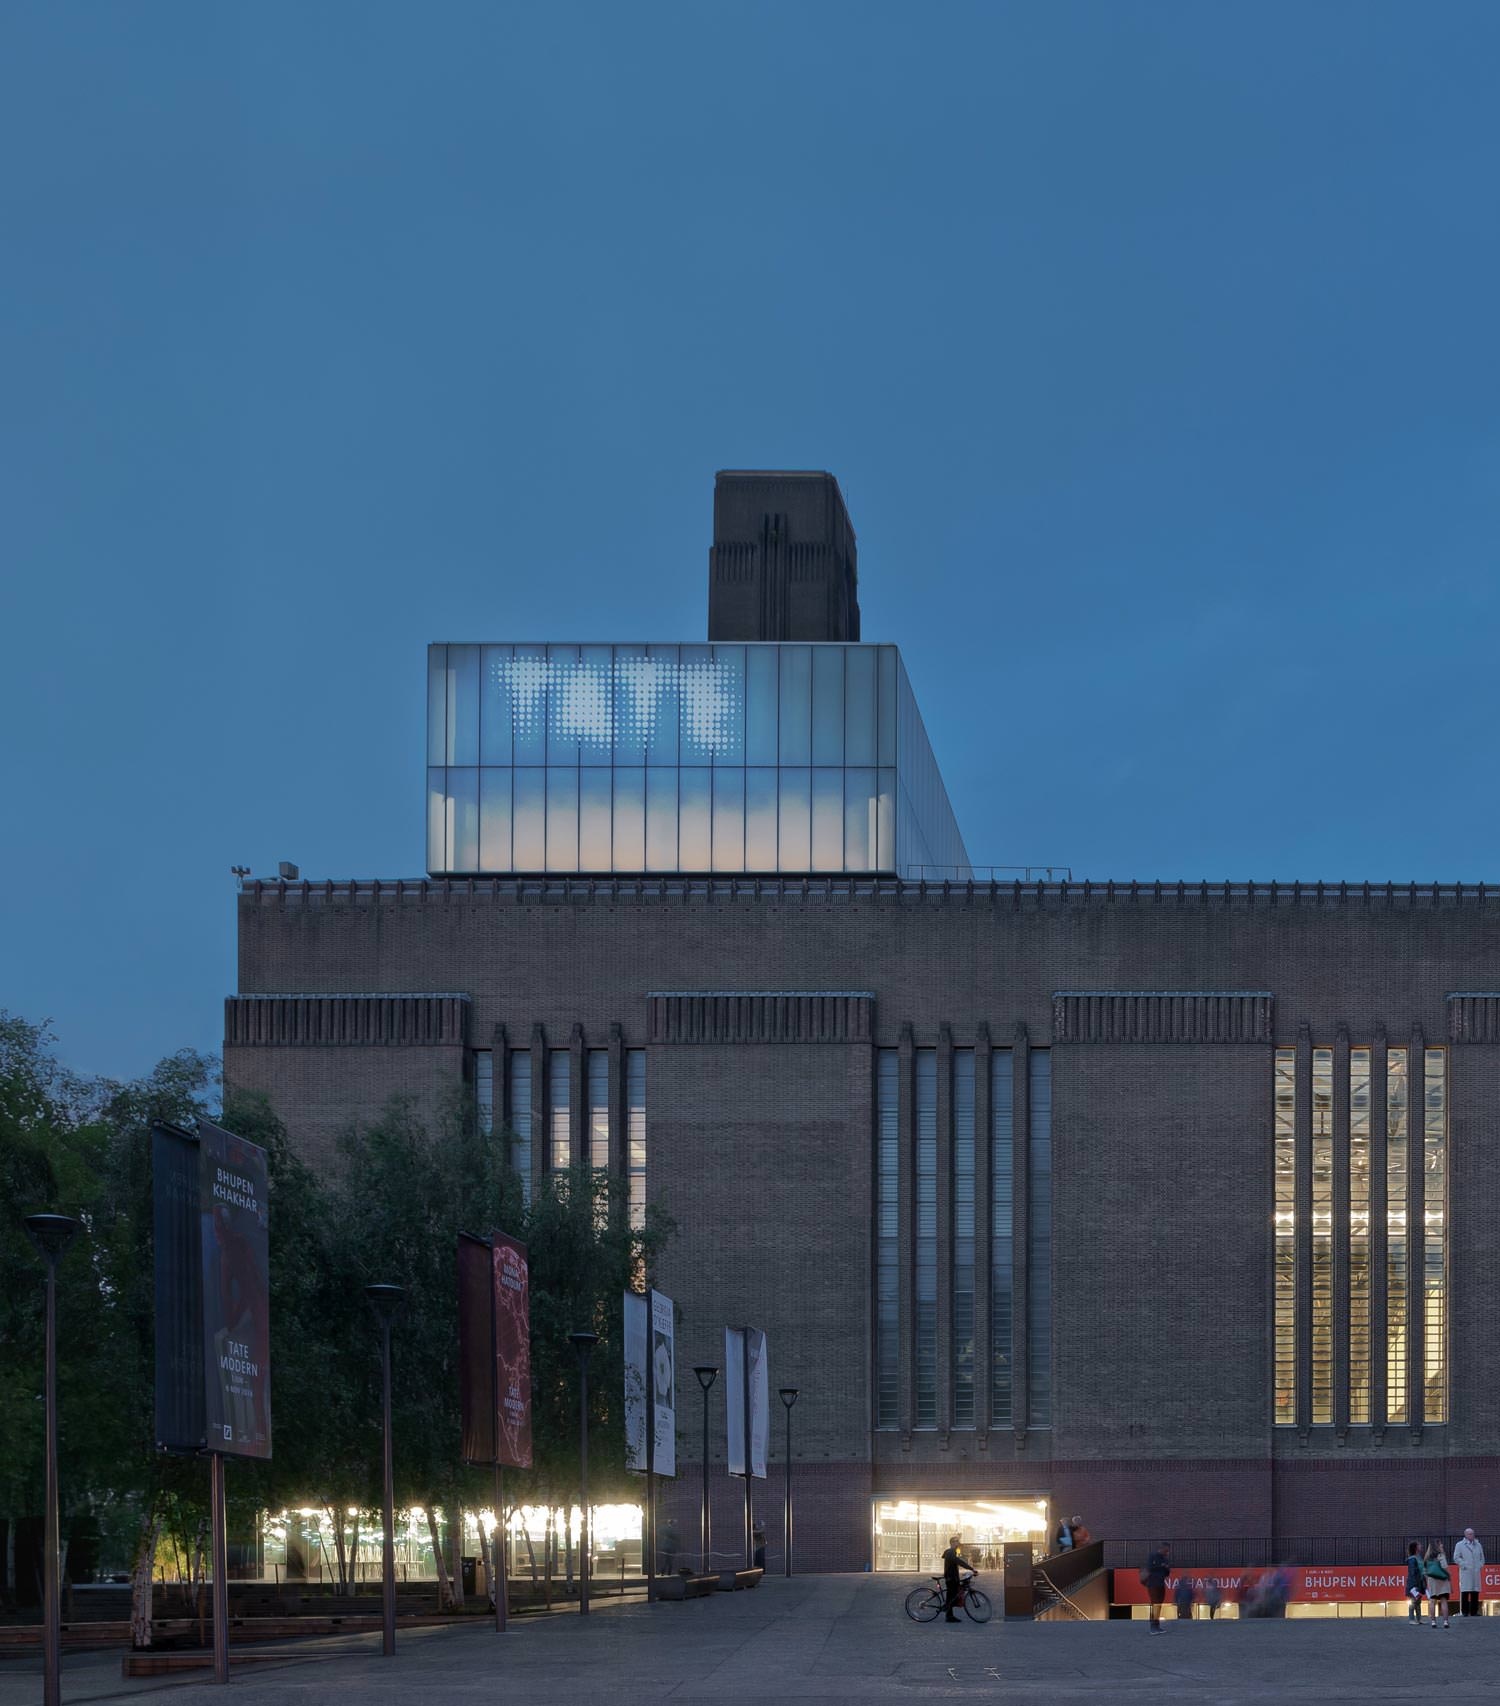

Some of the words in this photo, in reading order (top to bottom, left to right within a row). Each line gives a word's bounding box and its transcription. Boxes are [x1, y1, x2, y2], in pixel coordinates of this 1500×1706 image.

[217, 1168, 254, 1196] BHUPEN
[212, 1183, 258, 1212] KHAKHAR
[228, 1340, 249, 1359] TATE
[220, 1356, 258, 1377] MODERN
[1305, 1576, 1356, 1588] BHUPEN
[1361, 1575, 1405, 1587] KHAKH
